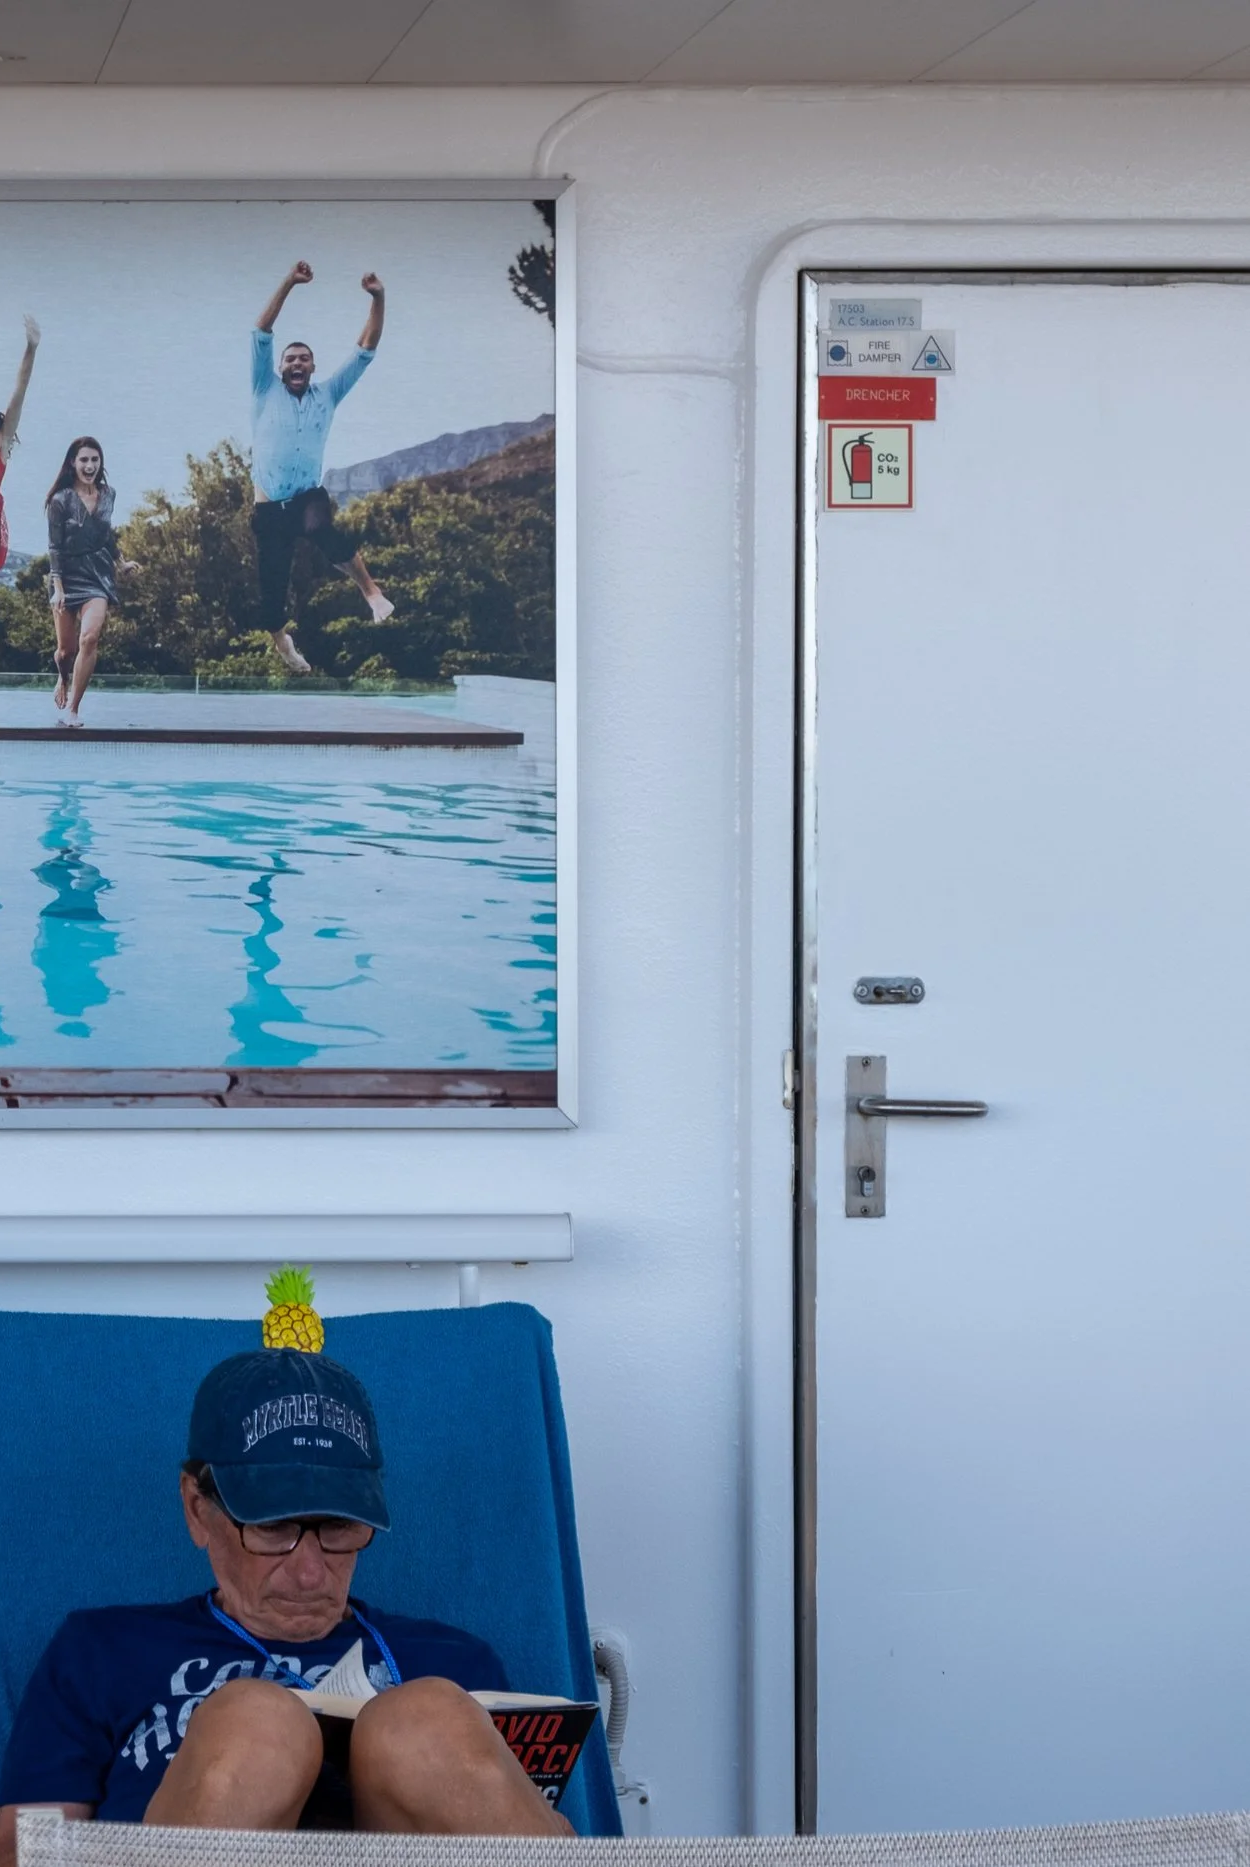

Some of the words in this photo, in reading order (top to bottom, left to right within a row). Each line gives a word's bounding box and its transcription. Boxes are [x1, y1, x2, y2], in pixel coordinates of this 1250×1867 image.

[838, 304, 865, 314] 17503
[860, 316, 895, 327] Station
[868, 341, 890, 350] FIRE
[858, 353, 901, 363] DAMPER
[846, 388, 910, 401] DRENCHER
[877, 466, 884, 474] 5
[886, 465, 900, 476] kg
[242, 1393, 318, 1452] MYRTLE
